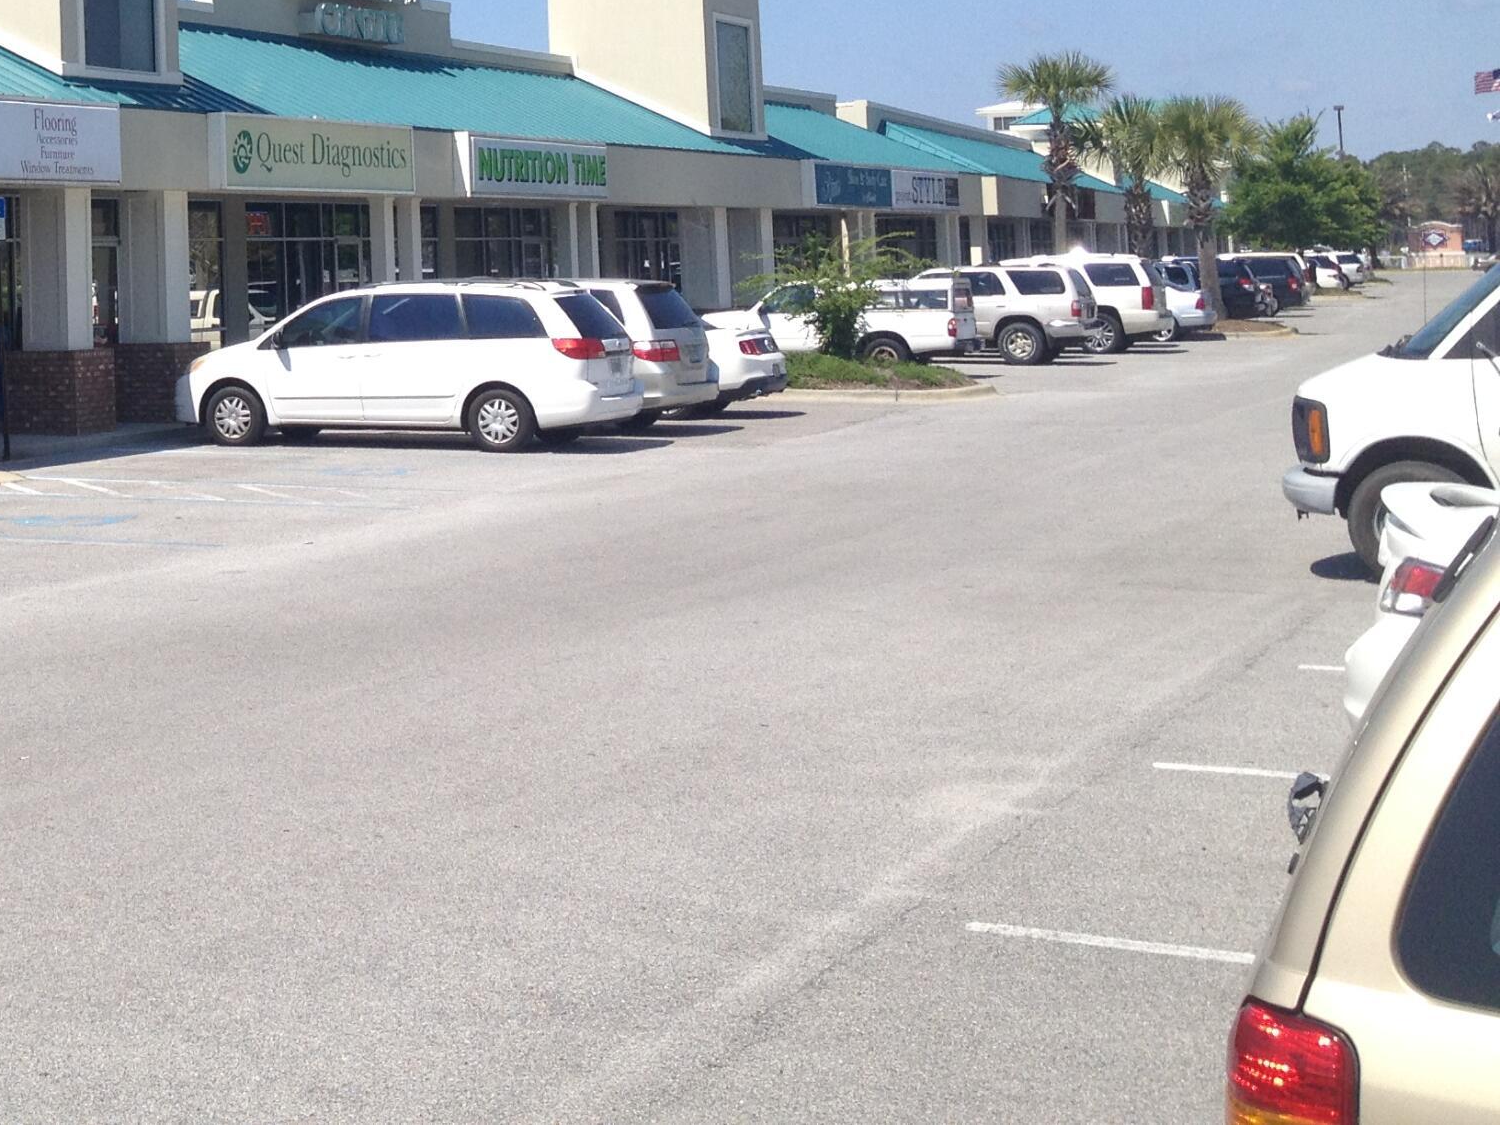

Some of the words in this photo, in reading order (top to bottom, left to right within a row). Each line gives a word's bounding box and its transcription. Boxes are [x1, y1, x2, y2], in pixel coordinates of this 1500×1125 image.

[33, 108, 78, 136] Flooring
[36, 133, 79, 146] Accessories
[20, 160, 51, 174] Window
[54, 163, 95, 175] Treatments
[256, 132, 305, 173] Quest
[312, 133, 407, 178] Diagnostics
[478, 147, 569, 184] NUTRITION
[572, 153, 607, 187] TIME
